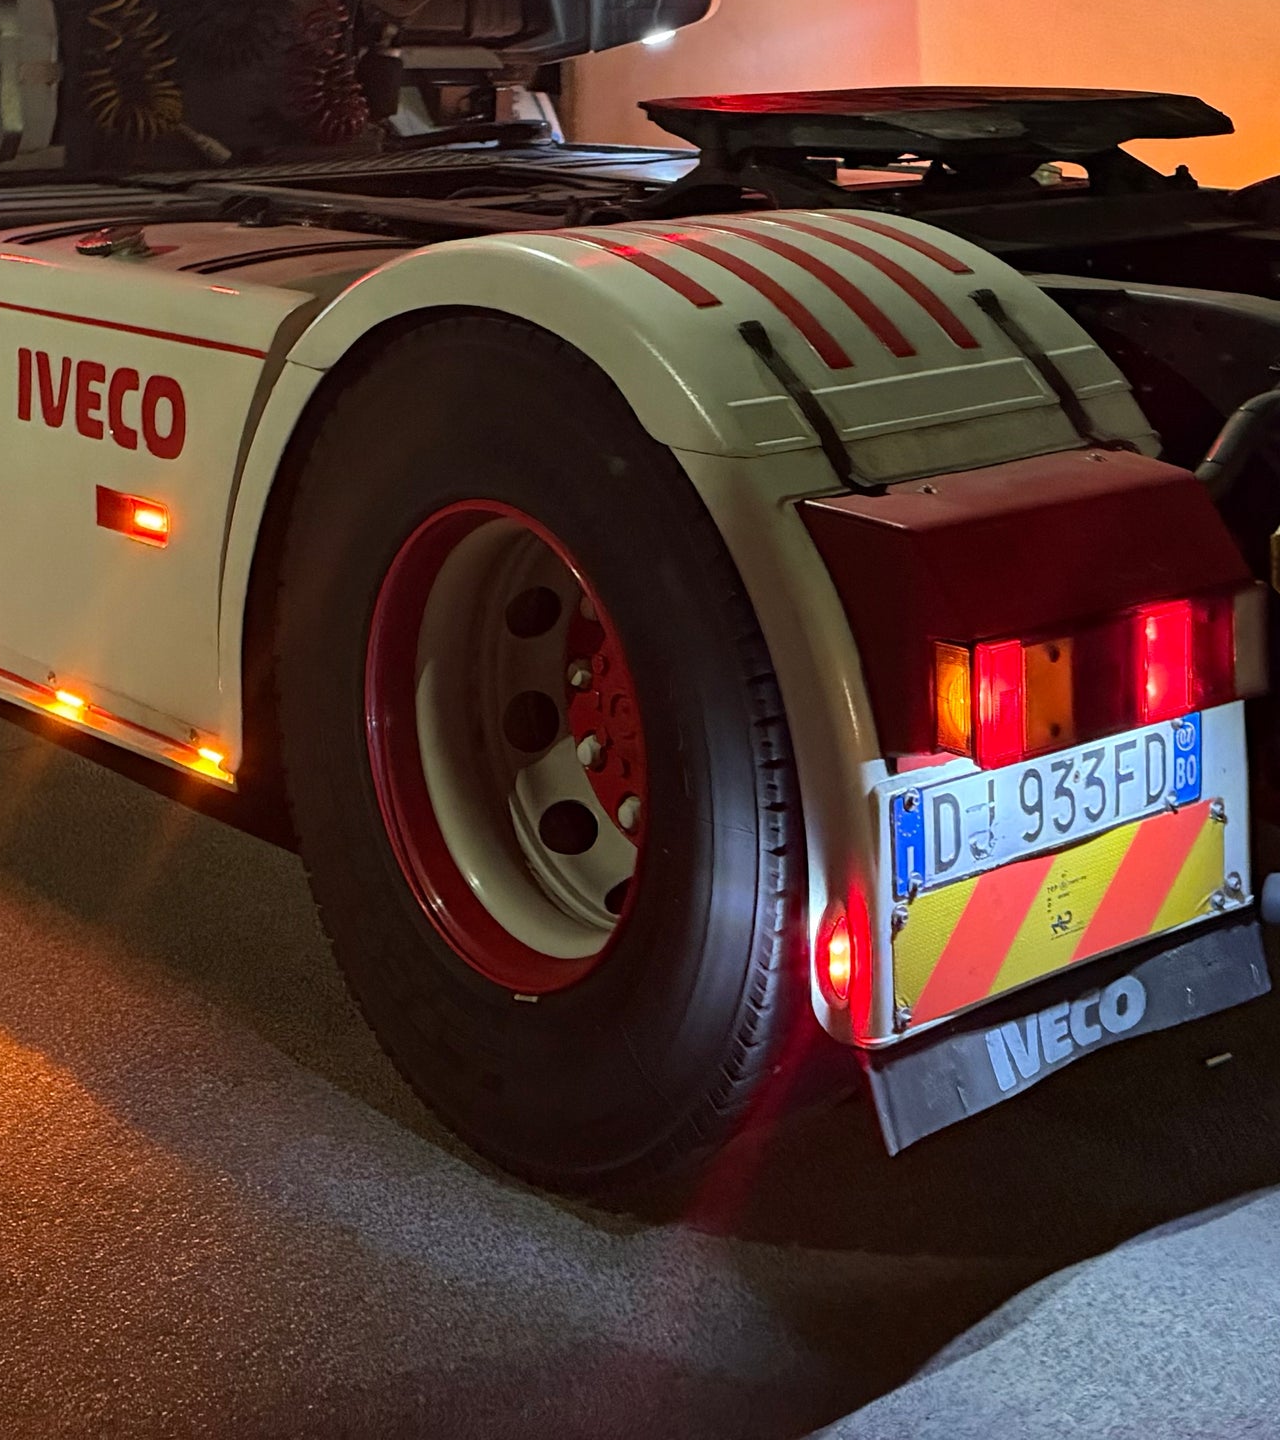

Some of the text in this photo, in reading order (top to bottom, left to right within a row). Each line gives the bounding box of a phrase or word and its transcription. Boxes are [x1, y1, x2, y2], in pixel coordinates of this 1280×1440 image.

[18, 347, 186, 460] IVECO
[1020, 732, 1167, 843] 933FD
[1176, 754, 1197, 790] BO
[985, 975, 1147, 1092] IVECO
